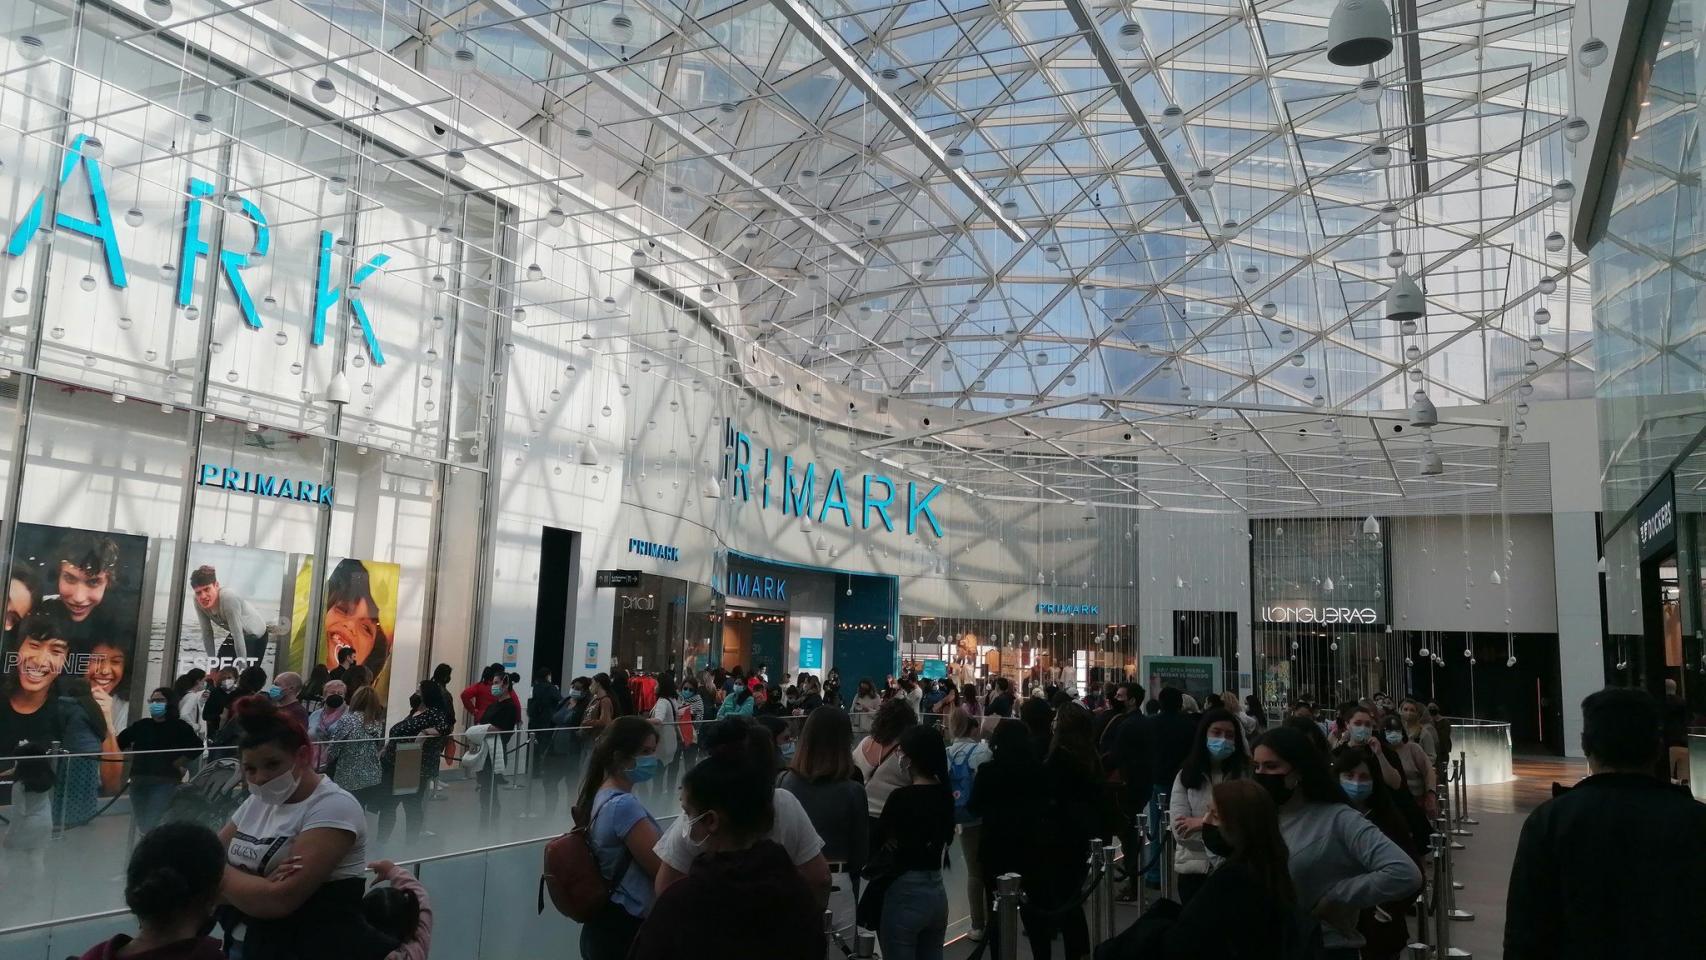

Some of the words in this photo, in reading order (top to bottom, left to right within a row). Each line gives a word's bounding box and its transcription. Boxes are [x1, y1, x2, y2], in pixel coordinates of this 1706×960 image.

[4, 133, 391, 366] ARK
[200, 464, 333, 506] PRIMARK
[1647, 500, 1672, 540] DOCKERS
[628, 538, 680, 562] PRIMARK
[712, 571, 786, 601] IMARK
[1035, 602, 1099, 616] PRIMARK
